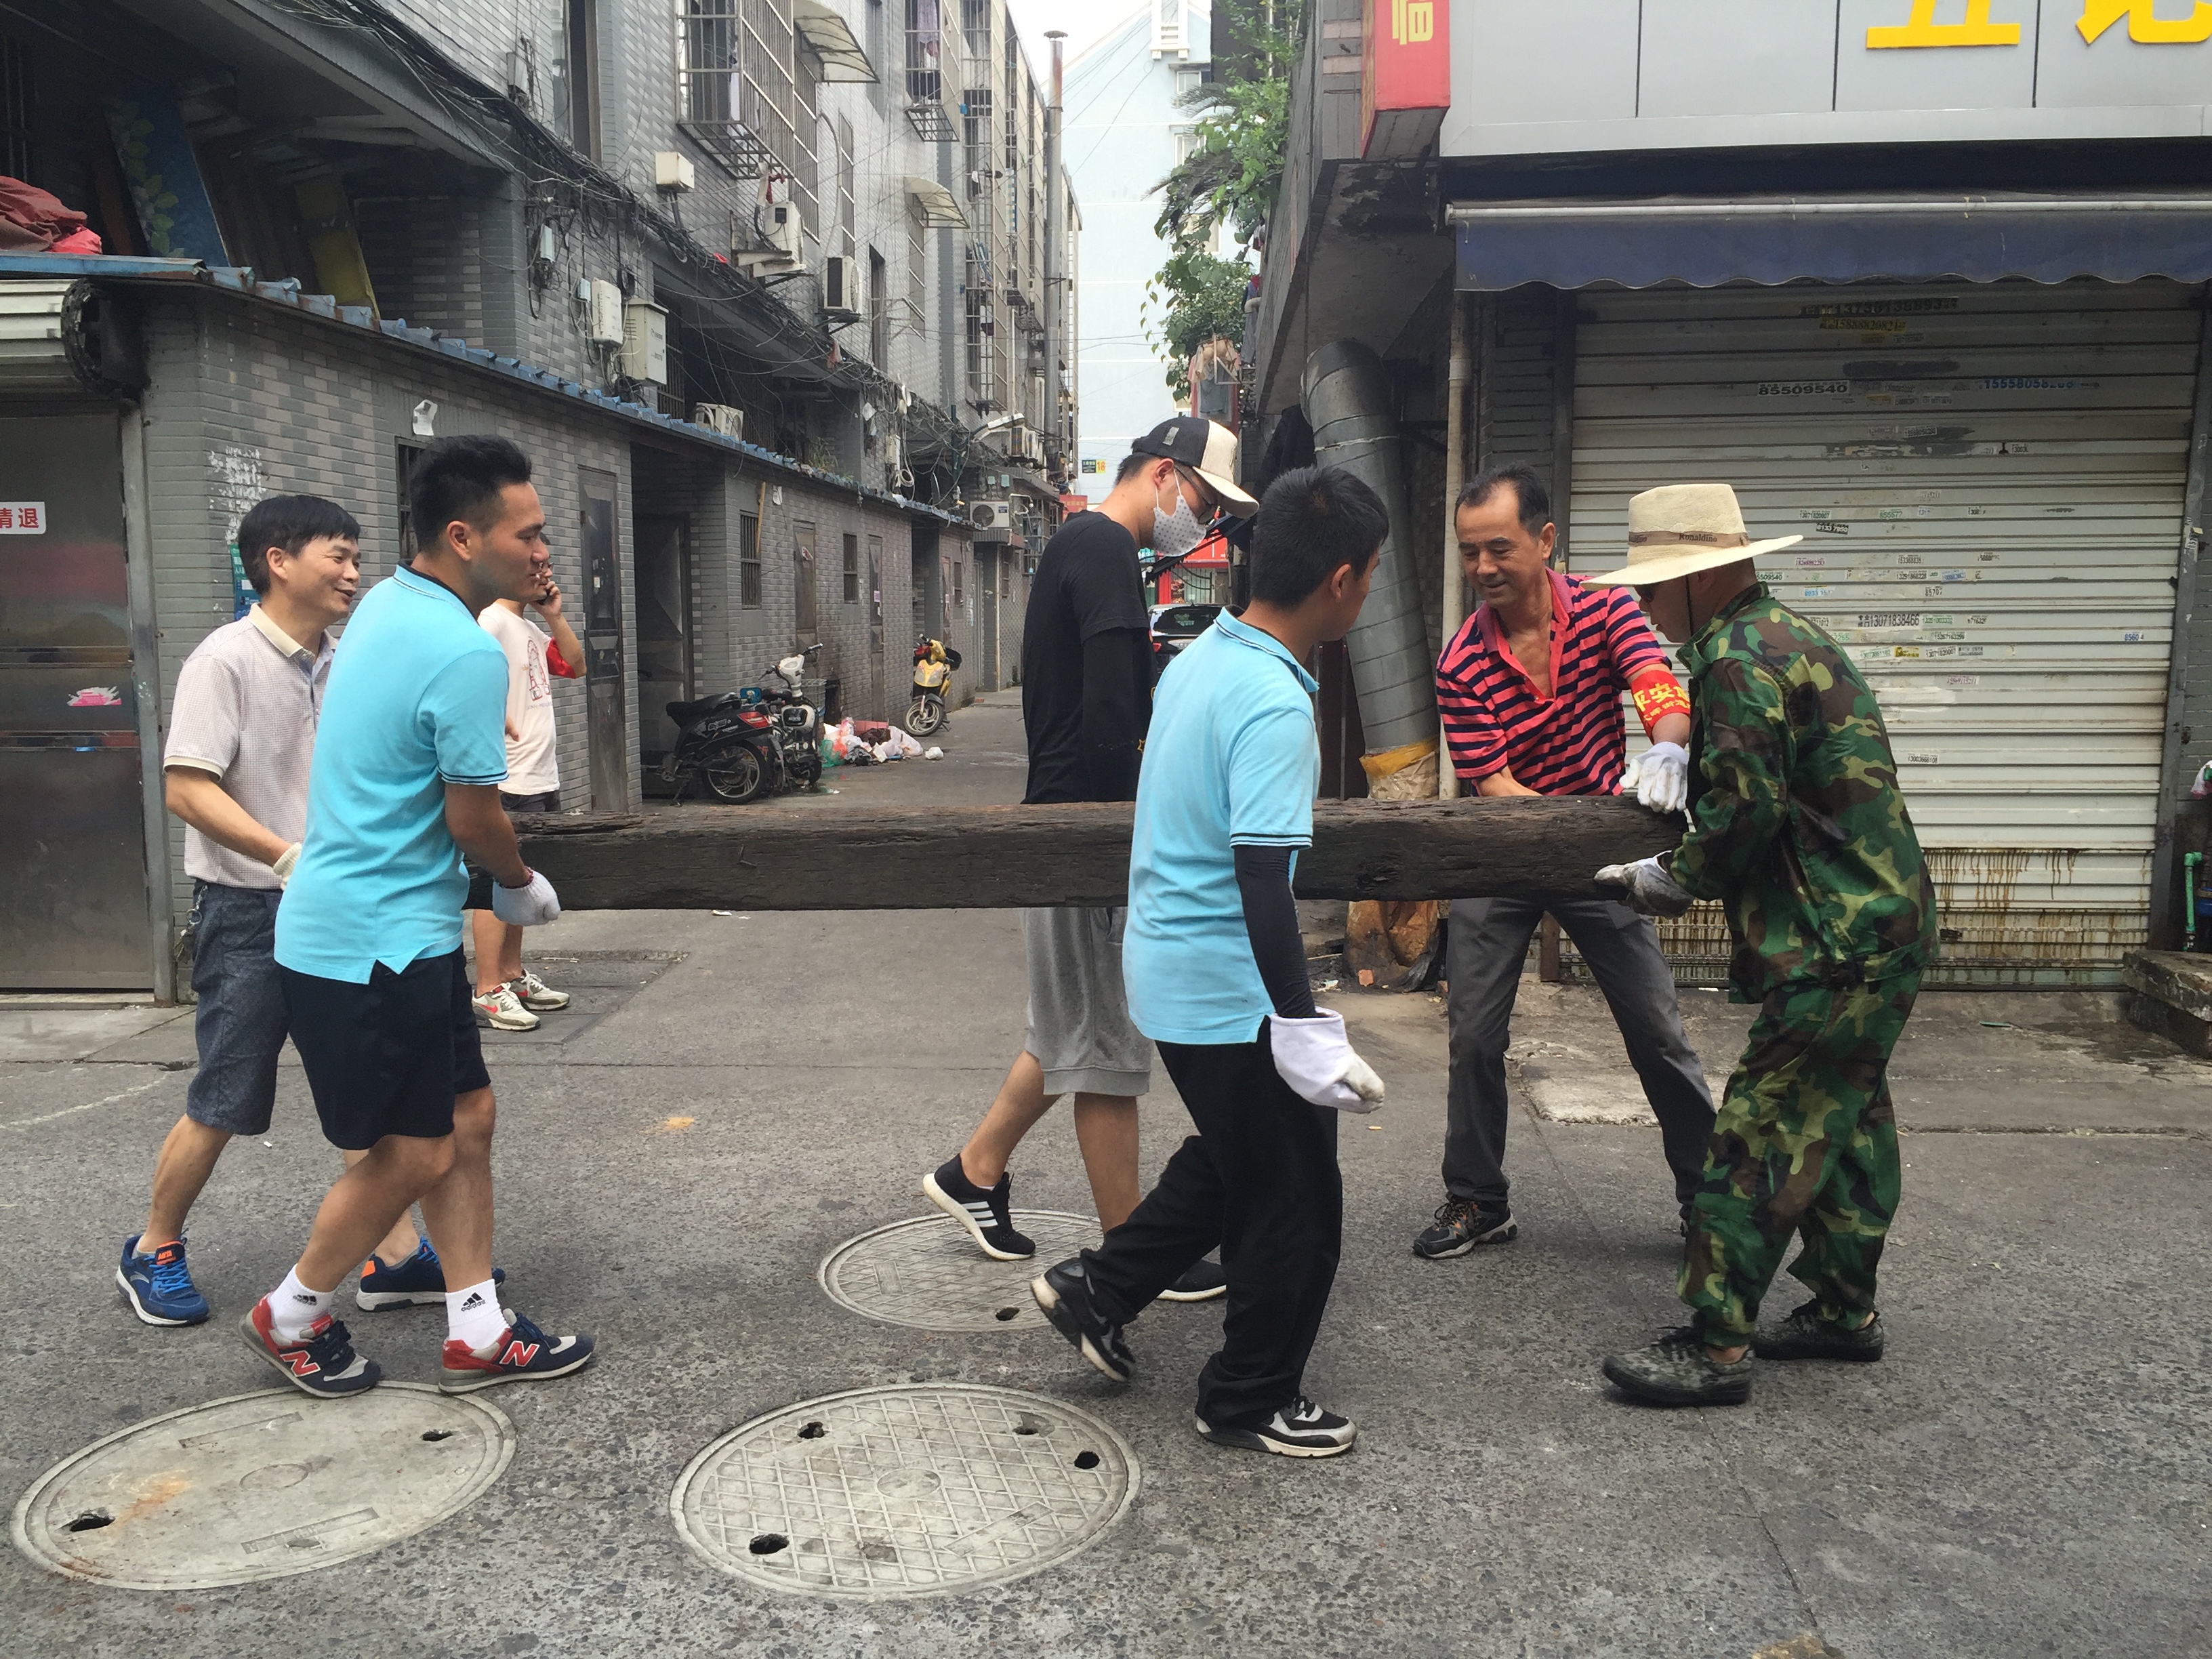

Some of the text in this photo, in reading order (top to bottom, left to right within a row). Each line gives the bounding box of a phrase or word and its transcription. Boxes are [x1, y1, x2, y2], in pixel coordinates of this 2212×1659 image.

[1759, 384, 1848, 396] 85509540
[1097, 462, 1105, 471] 18
[1679, 533, 1717, 543] Ronaldino
[1870, 613, 1920, 627] 13071838466
[461, 1299, 486, 1312] adidas
[499, 1340, 540, 1367] N
[280, 1350, 321, 1377] N
